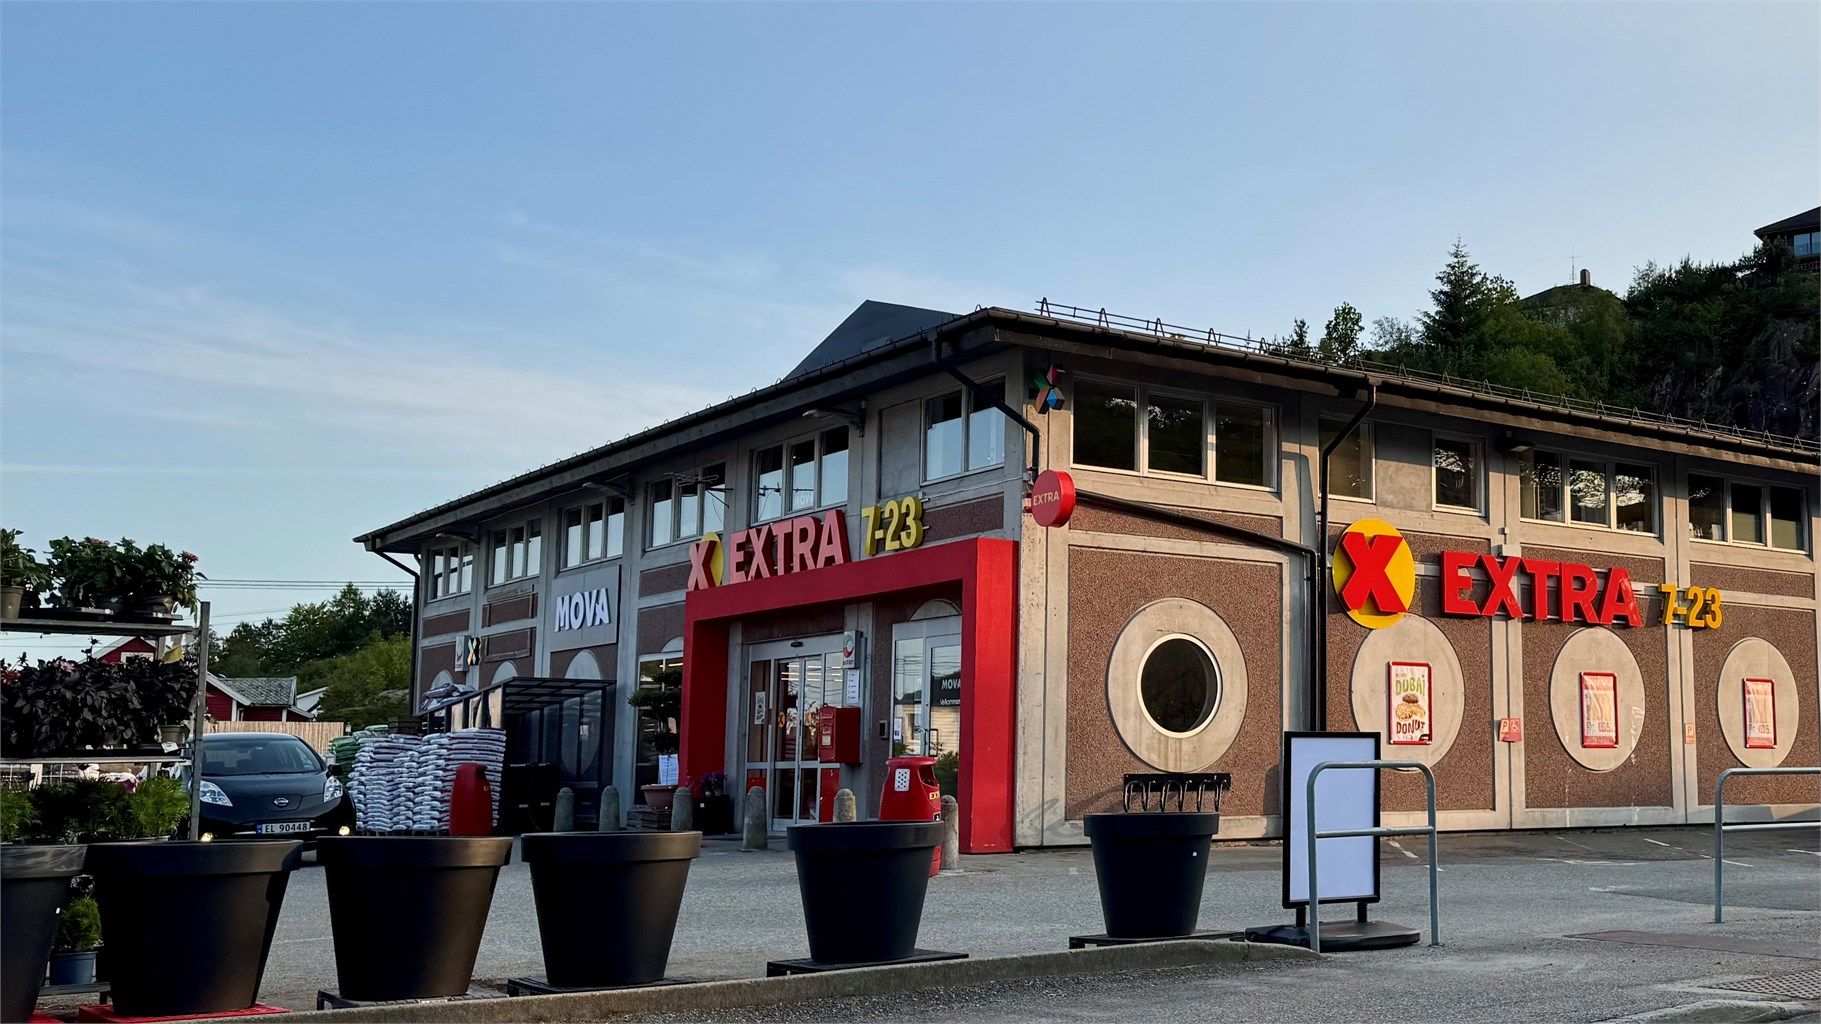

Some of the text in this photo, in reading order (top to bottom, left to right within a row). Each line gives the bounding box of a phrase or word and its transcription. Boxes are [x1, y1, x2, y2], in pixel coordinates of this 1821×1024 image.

[1033, 491, 1059, 505] EXTRA
[729, 509, 851, 584] EXTRA
[861, 496, 923, 557] 7-23
[1341, 531, 1724, 630] X EXTRA 7-23
[555, 587, 611, 633] MOVA
[1396, 719, 1425, 734] DONUT
[279, 823, 307, 832] 90448
